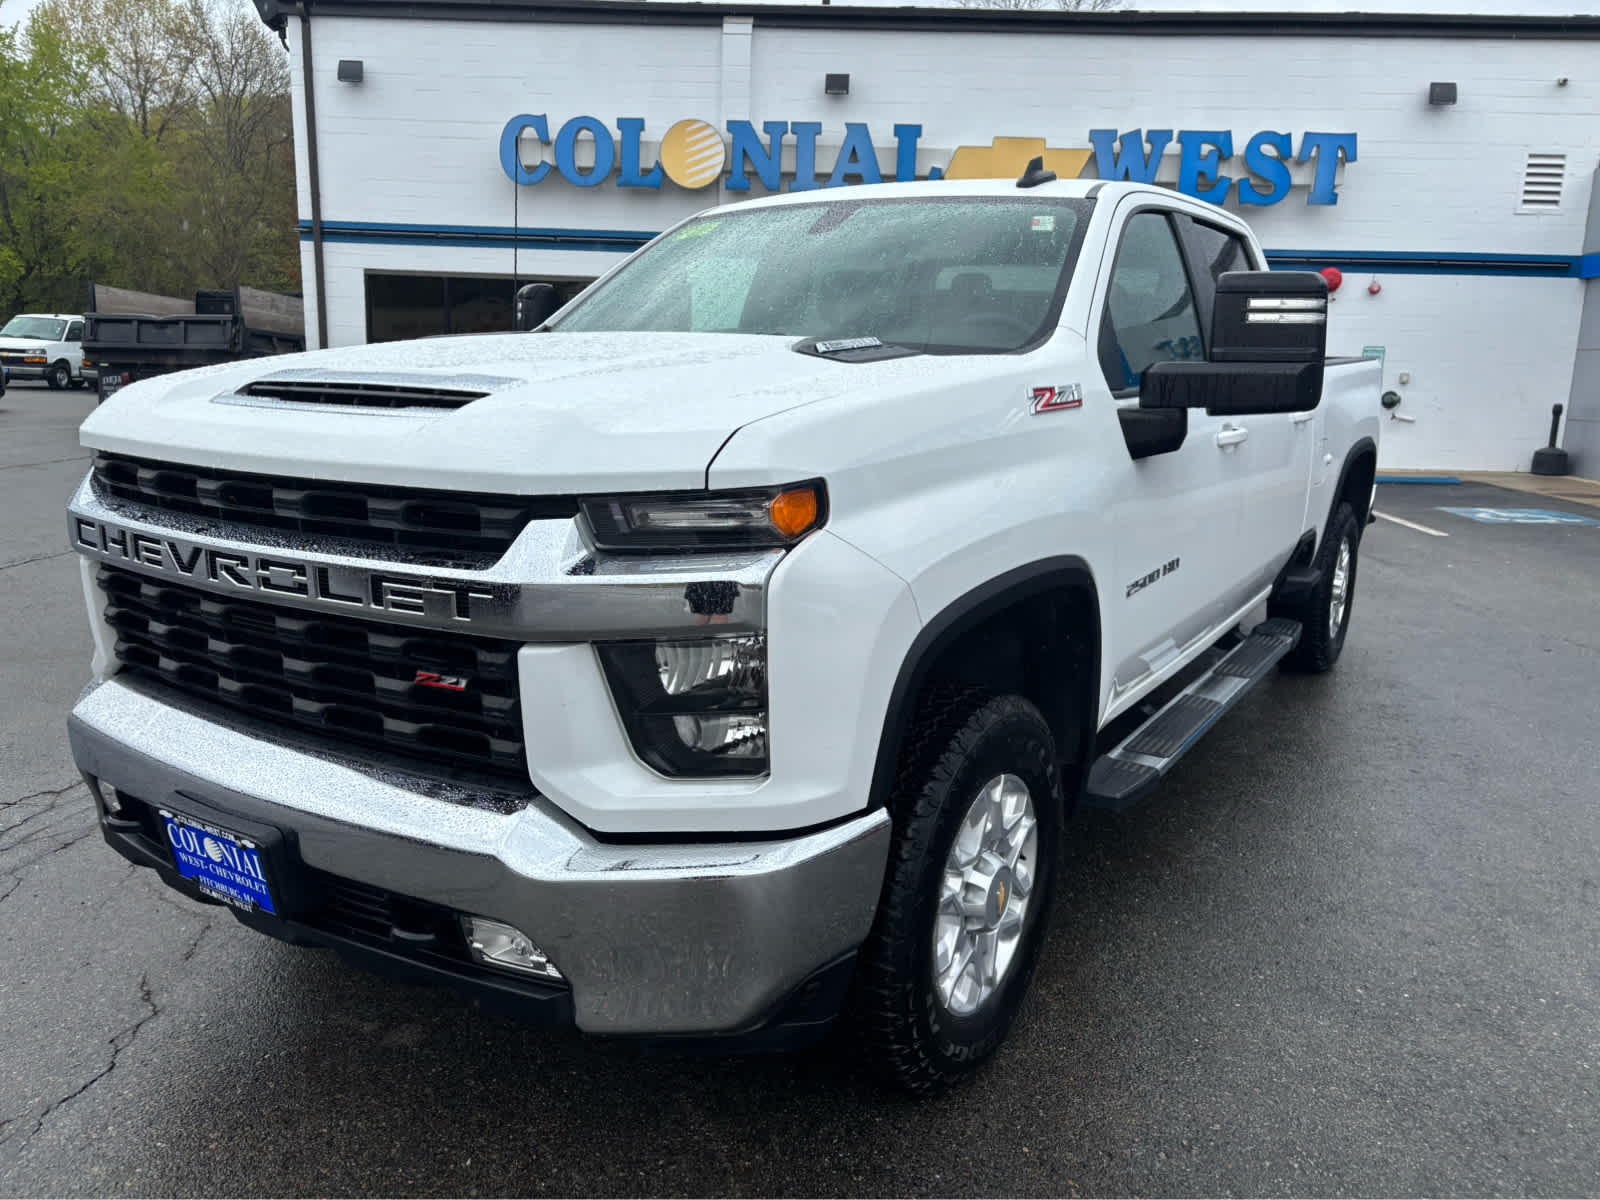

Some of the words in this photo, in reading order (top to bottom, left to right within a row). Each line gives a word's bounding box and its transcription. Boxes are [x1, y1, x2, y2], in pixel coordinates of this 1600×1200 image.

[1089, 128, 1357, 206] WEST
[76, 517, 495, 622] CHEVROLET
[209, 863, 267, 895] CHEVROLET
